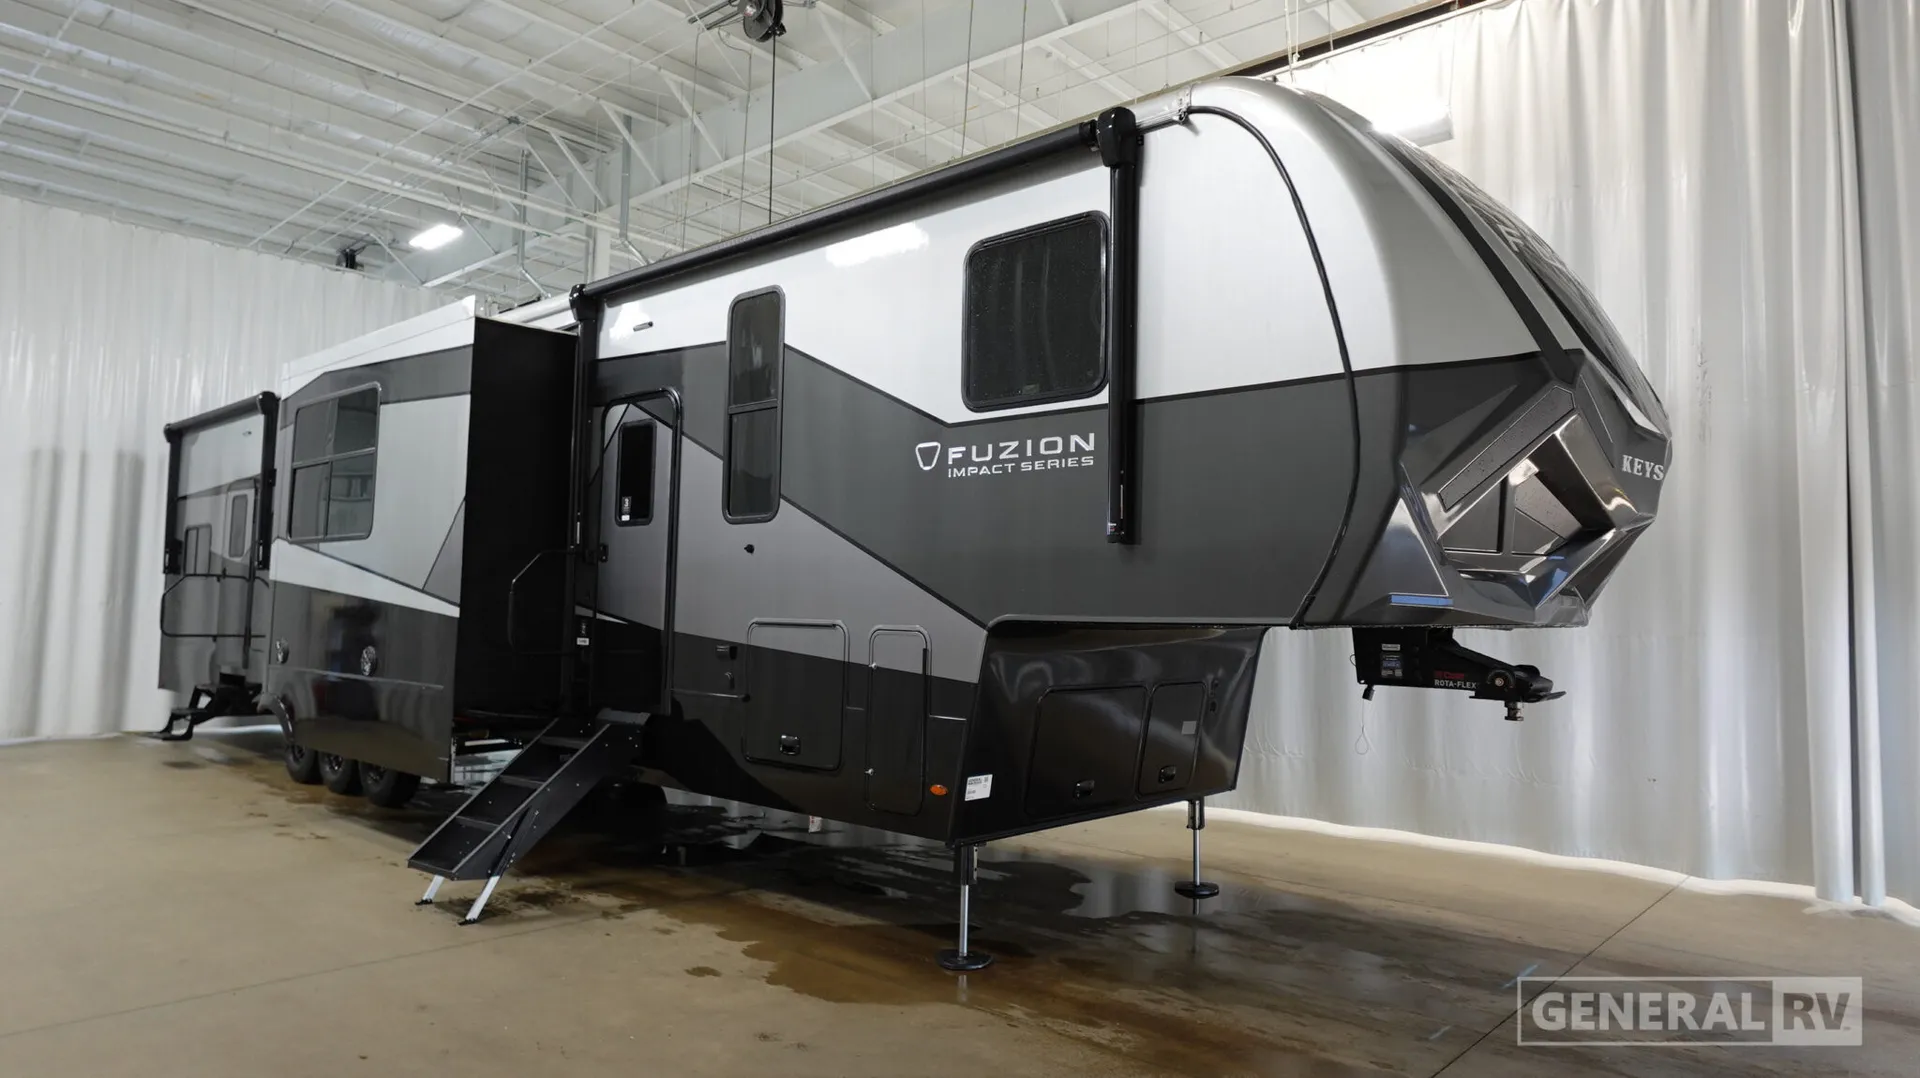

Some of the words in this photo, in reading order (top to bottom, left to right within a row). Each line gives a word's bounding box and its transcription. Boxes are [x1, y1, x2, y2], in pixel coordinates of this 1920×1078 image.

[948, 433, 1095, 464] FUZION
[948, 463, 1015, 478] IMPACT
[1020, 456, 1094, 472] SERIES
[1622, 455, 1665, 480] KEYS
[1434, 679, 1477, 690] ROTA-FLEX
